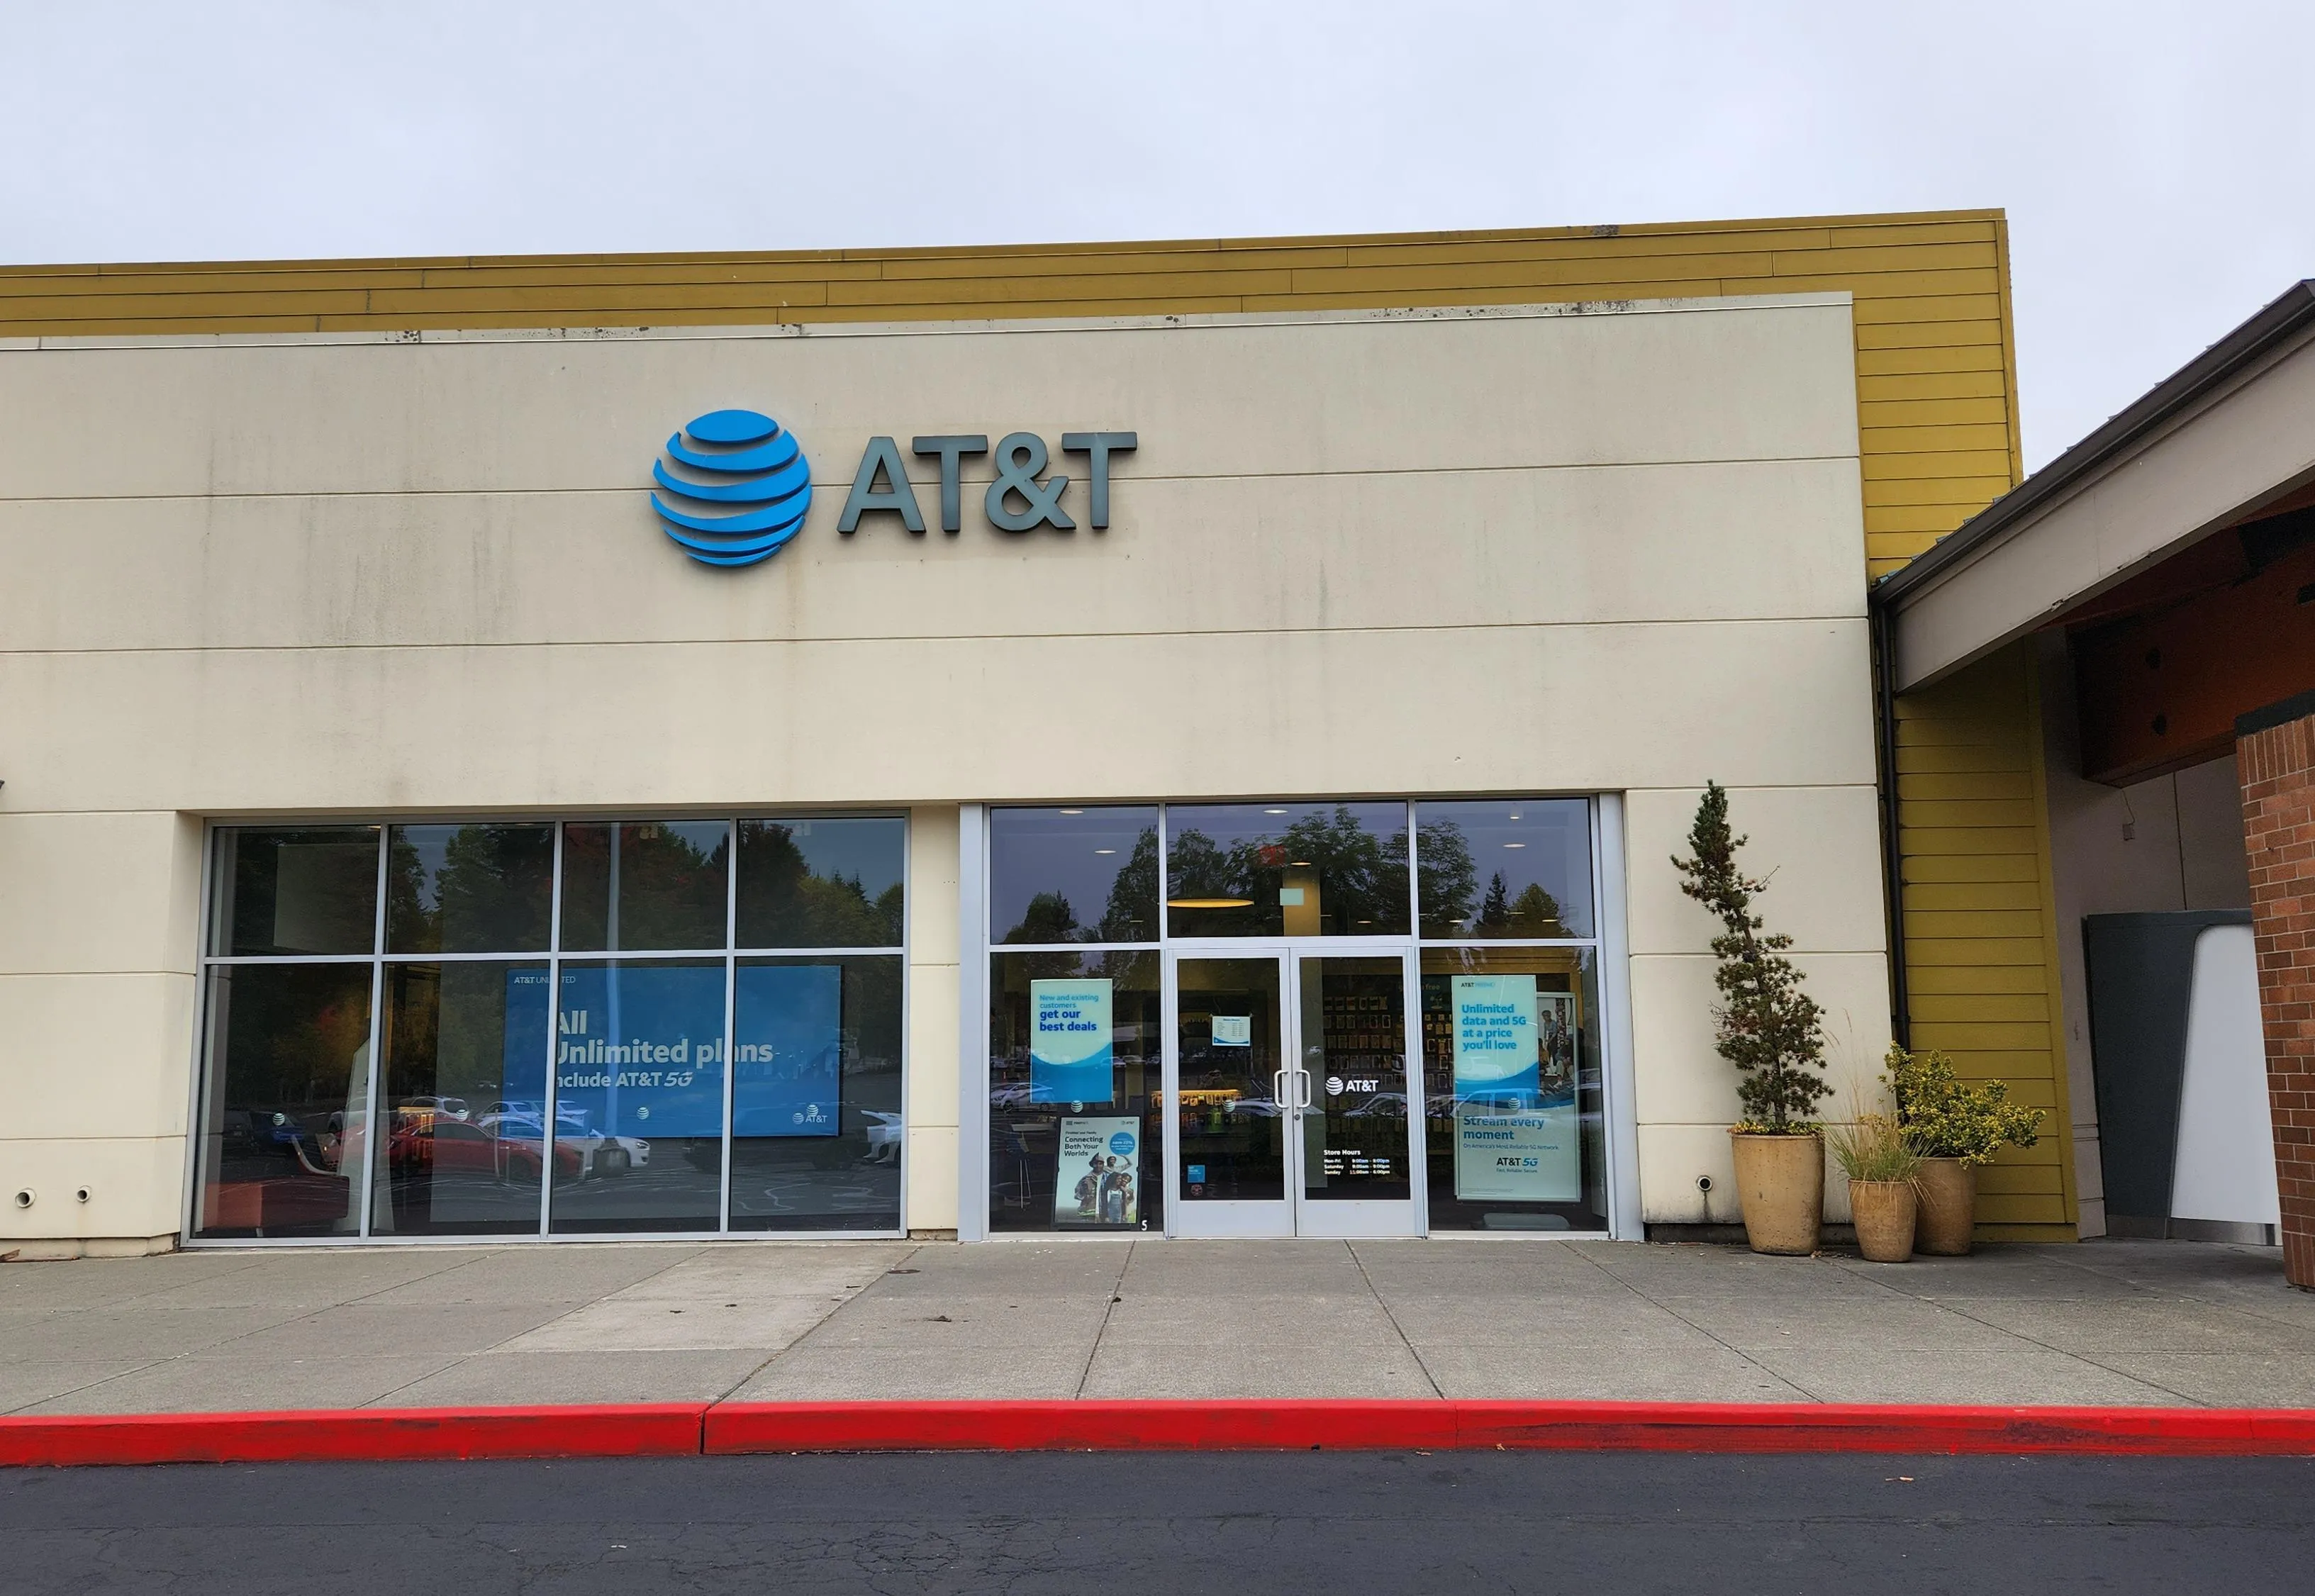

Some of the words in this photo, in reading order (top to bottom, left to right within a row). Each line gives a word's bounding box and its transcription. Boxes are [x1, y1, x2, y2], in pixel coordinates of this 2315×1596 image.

[837, 431, 1137, 535] AT&T
[536, 976, 576, 984] UNLTED
[1462, 1003, 1514, 1013] Unlimited
[1039, 1010, 1059, 1021] get
[1039, 1022, 1064, 1031] best
[1067, 1021, 1097, 1031] deals
[1462, 1017, 1487, 1025] data
[1490, 1017, 1510, 1025] and
[1512, 1017, 1527, 1025] 5G
[1463, 1029, 1474, 1038] at
[1485, 1029, 1512, 1039] price
[1462, 1040, 1492, 1051] you'll
[1495, 1040, 1517, 1049] love
[557, 1072, 610, 1088] nclude
[615, 1072, 662, 1087] AT&T
[664, 1071, 693, 1087] 5G
[1346, 1080, 1379, 1093] AT&T
[805, 1115, 828, 1123] AT&T
[1463, 1116, 1507, 1127] Stream
[1511, 1119, 1544, 1129] every
[1463, 1130, 1514, 1139] moment
[1496, 1157, 1521, 1166] AT&T
[1522, 1158, 1538, 1166] 5G
[1142, 1220, 1147, 1231] 5
